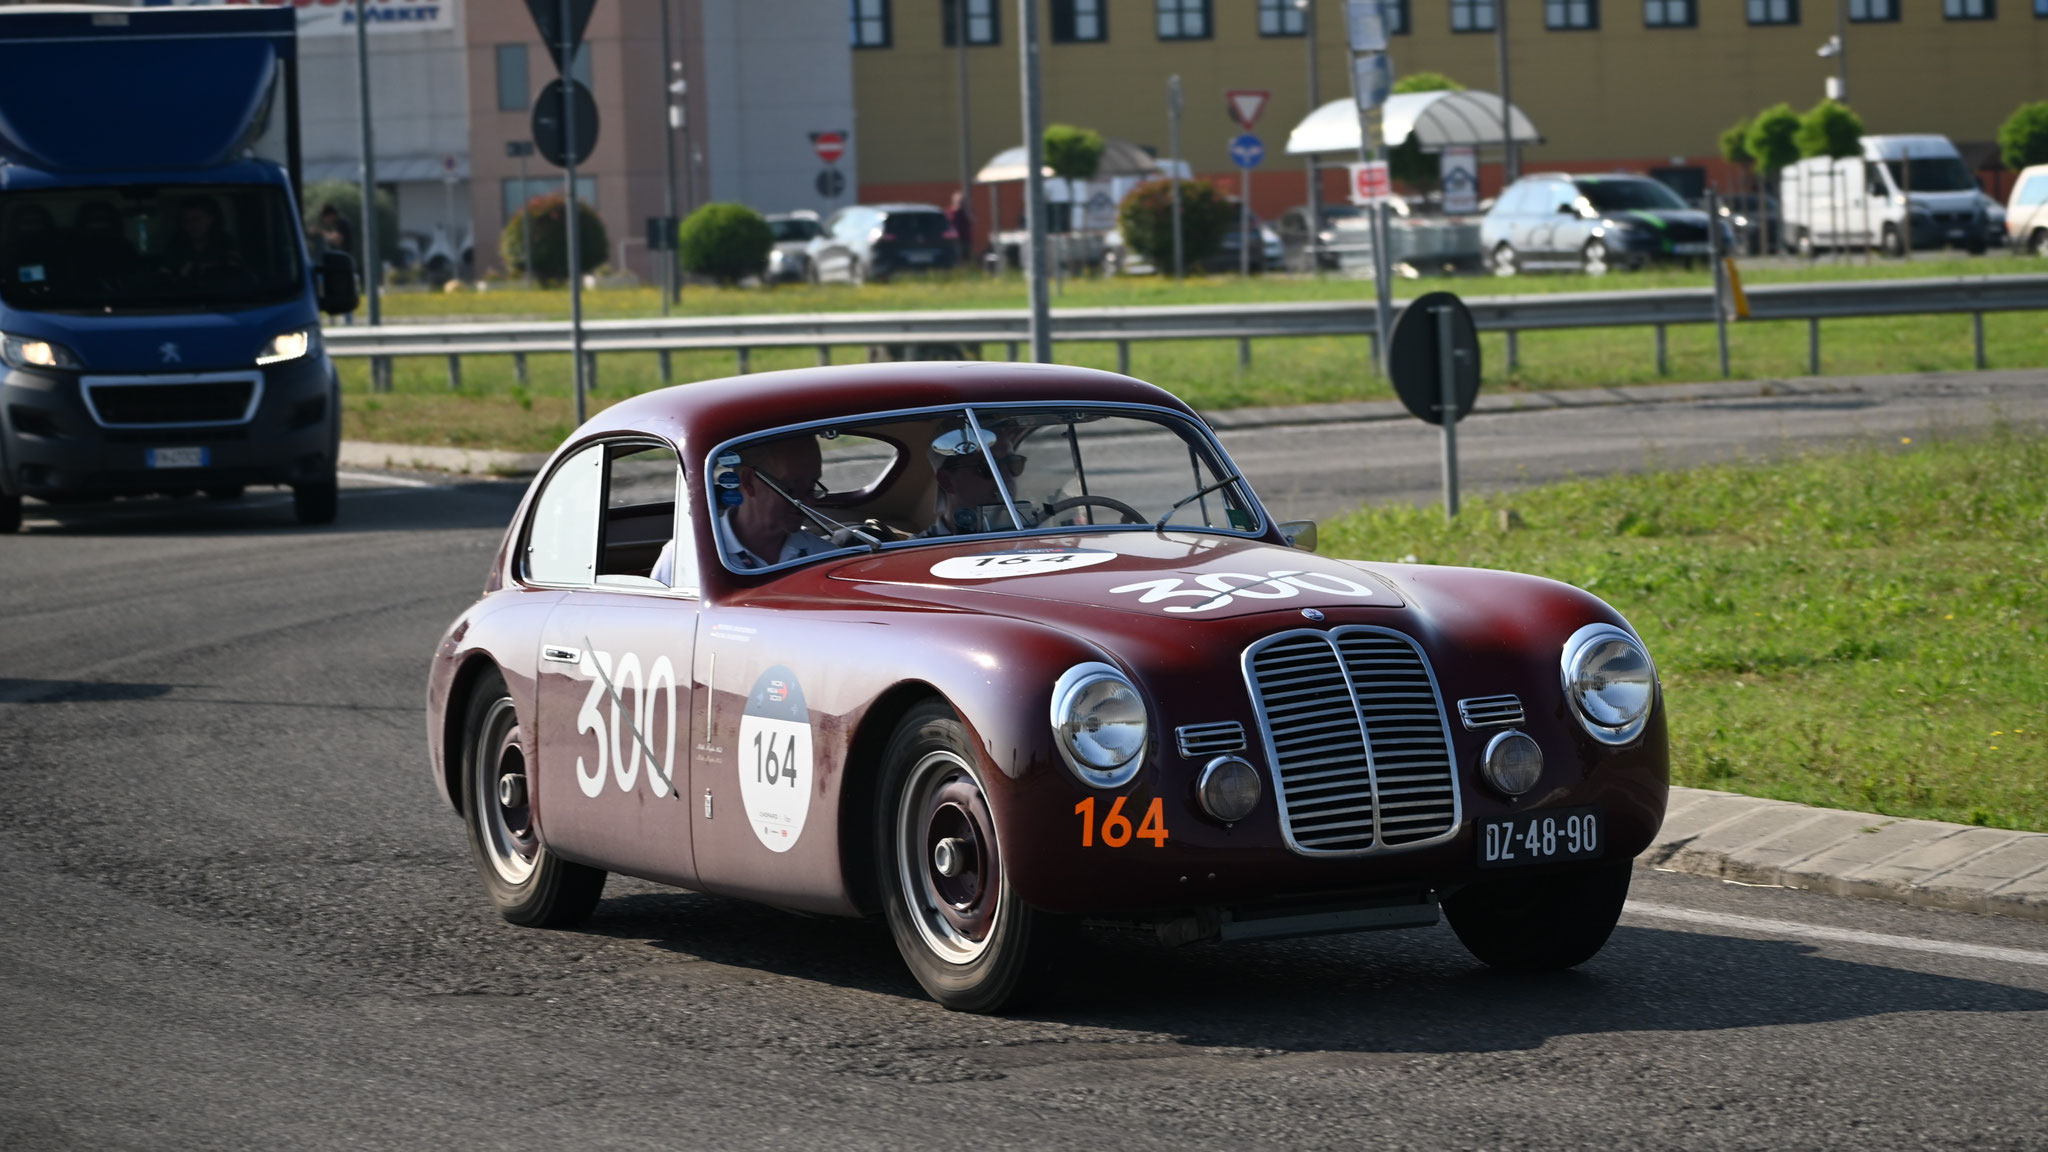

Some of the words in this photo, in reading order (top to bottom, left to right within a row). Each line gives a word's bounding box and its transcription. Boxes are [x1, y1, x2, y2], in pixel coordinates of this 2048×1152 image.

[975, 554, 1074, 567] 164
[1109, 570, 1373, 612] 300
[577, 651, 676, 798] 300
[753, 731, 797, 788] 164
[1074, 796, 1169, 848] 164
[1486, 814, 1597, 861] DZ-48-90
